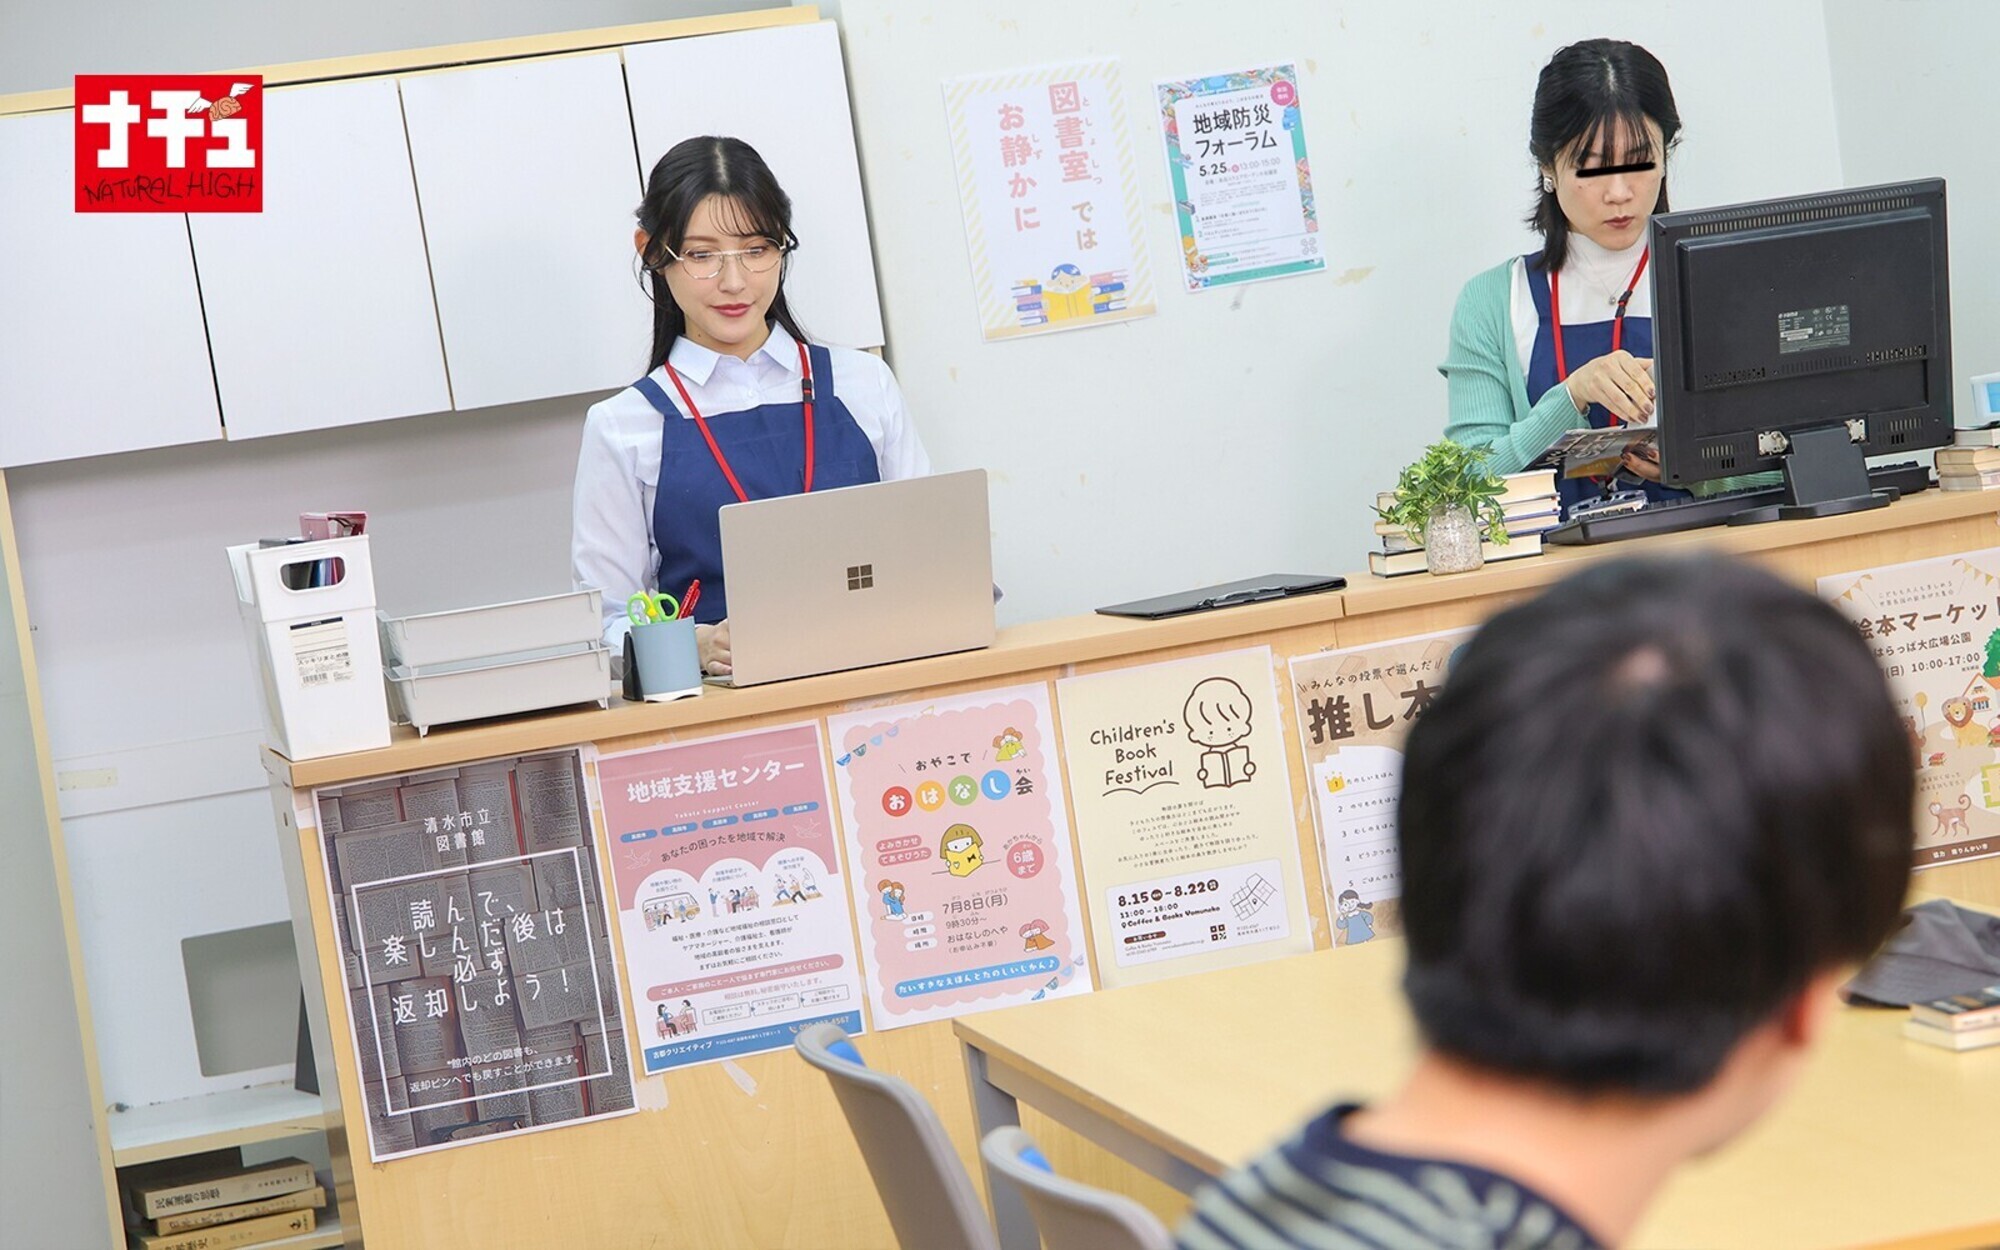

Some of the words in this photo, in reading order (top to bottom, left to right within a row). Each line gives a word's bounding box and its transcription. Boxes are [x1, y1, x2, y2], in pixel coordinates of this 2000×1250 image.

[1193, 103, 1273, 135] 地域防災
[1195, 129, 1278, 158] フォーラム
[998, 103, 1041, 232] お静かに
[1854, 596, 2000, 640] 絵本マーケッ
[1310, 660, 1432, 690] みんなの投票で選んだ
[1911, 652, 1981, 673] 10:00-17:00
[1090, 719, 1175, 745] Children's
[915, 752, 973, 771] おやこで
[1115, 742, 1157, 764] Book
[627, 759, 805, 803] 地域支援センター
[1105, 760, 1173, 786] Festival
[424, 808, 492, 834] 清水市立
[435, 828, 486, 853] 図書館
[660, 831, 786, 863] あなたの困ったを地域で解決
[878, 836, 919, 850] よみきかせ
[881, 849, 929, 864] てあそびうた
[942, 893, 1009, 915] 7月8日(月)
[1118, 890, 1149, 907] 8.15
[1174, 881, 1206, 897] 8.22
[410, 891, 516, 931] 読んで、
[947, 925, 1009, 944] おはなしのへや
[453, 949, 507, 984] 必ず
[653, 1041, 712, 1060] 古都クリエイティブ
